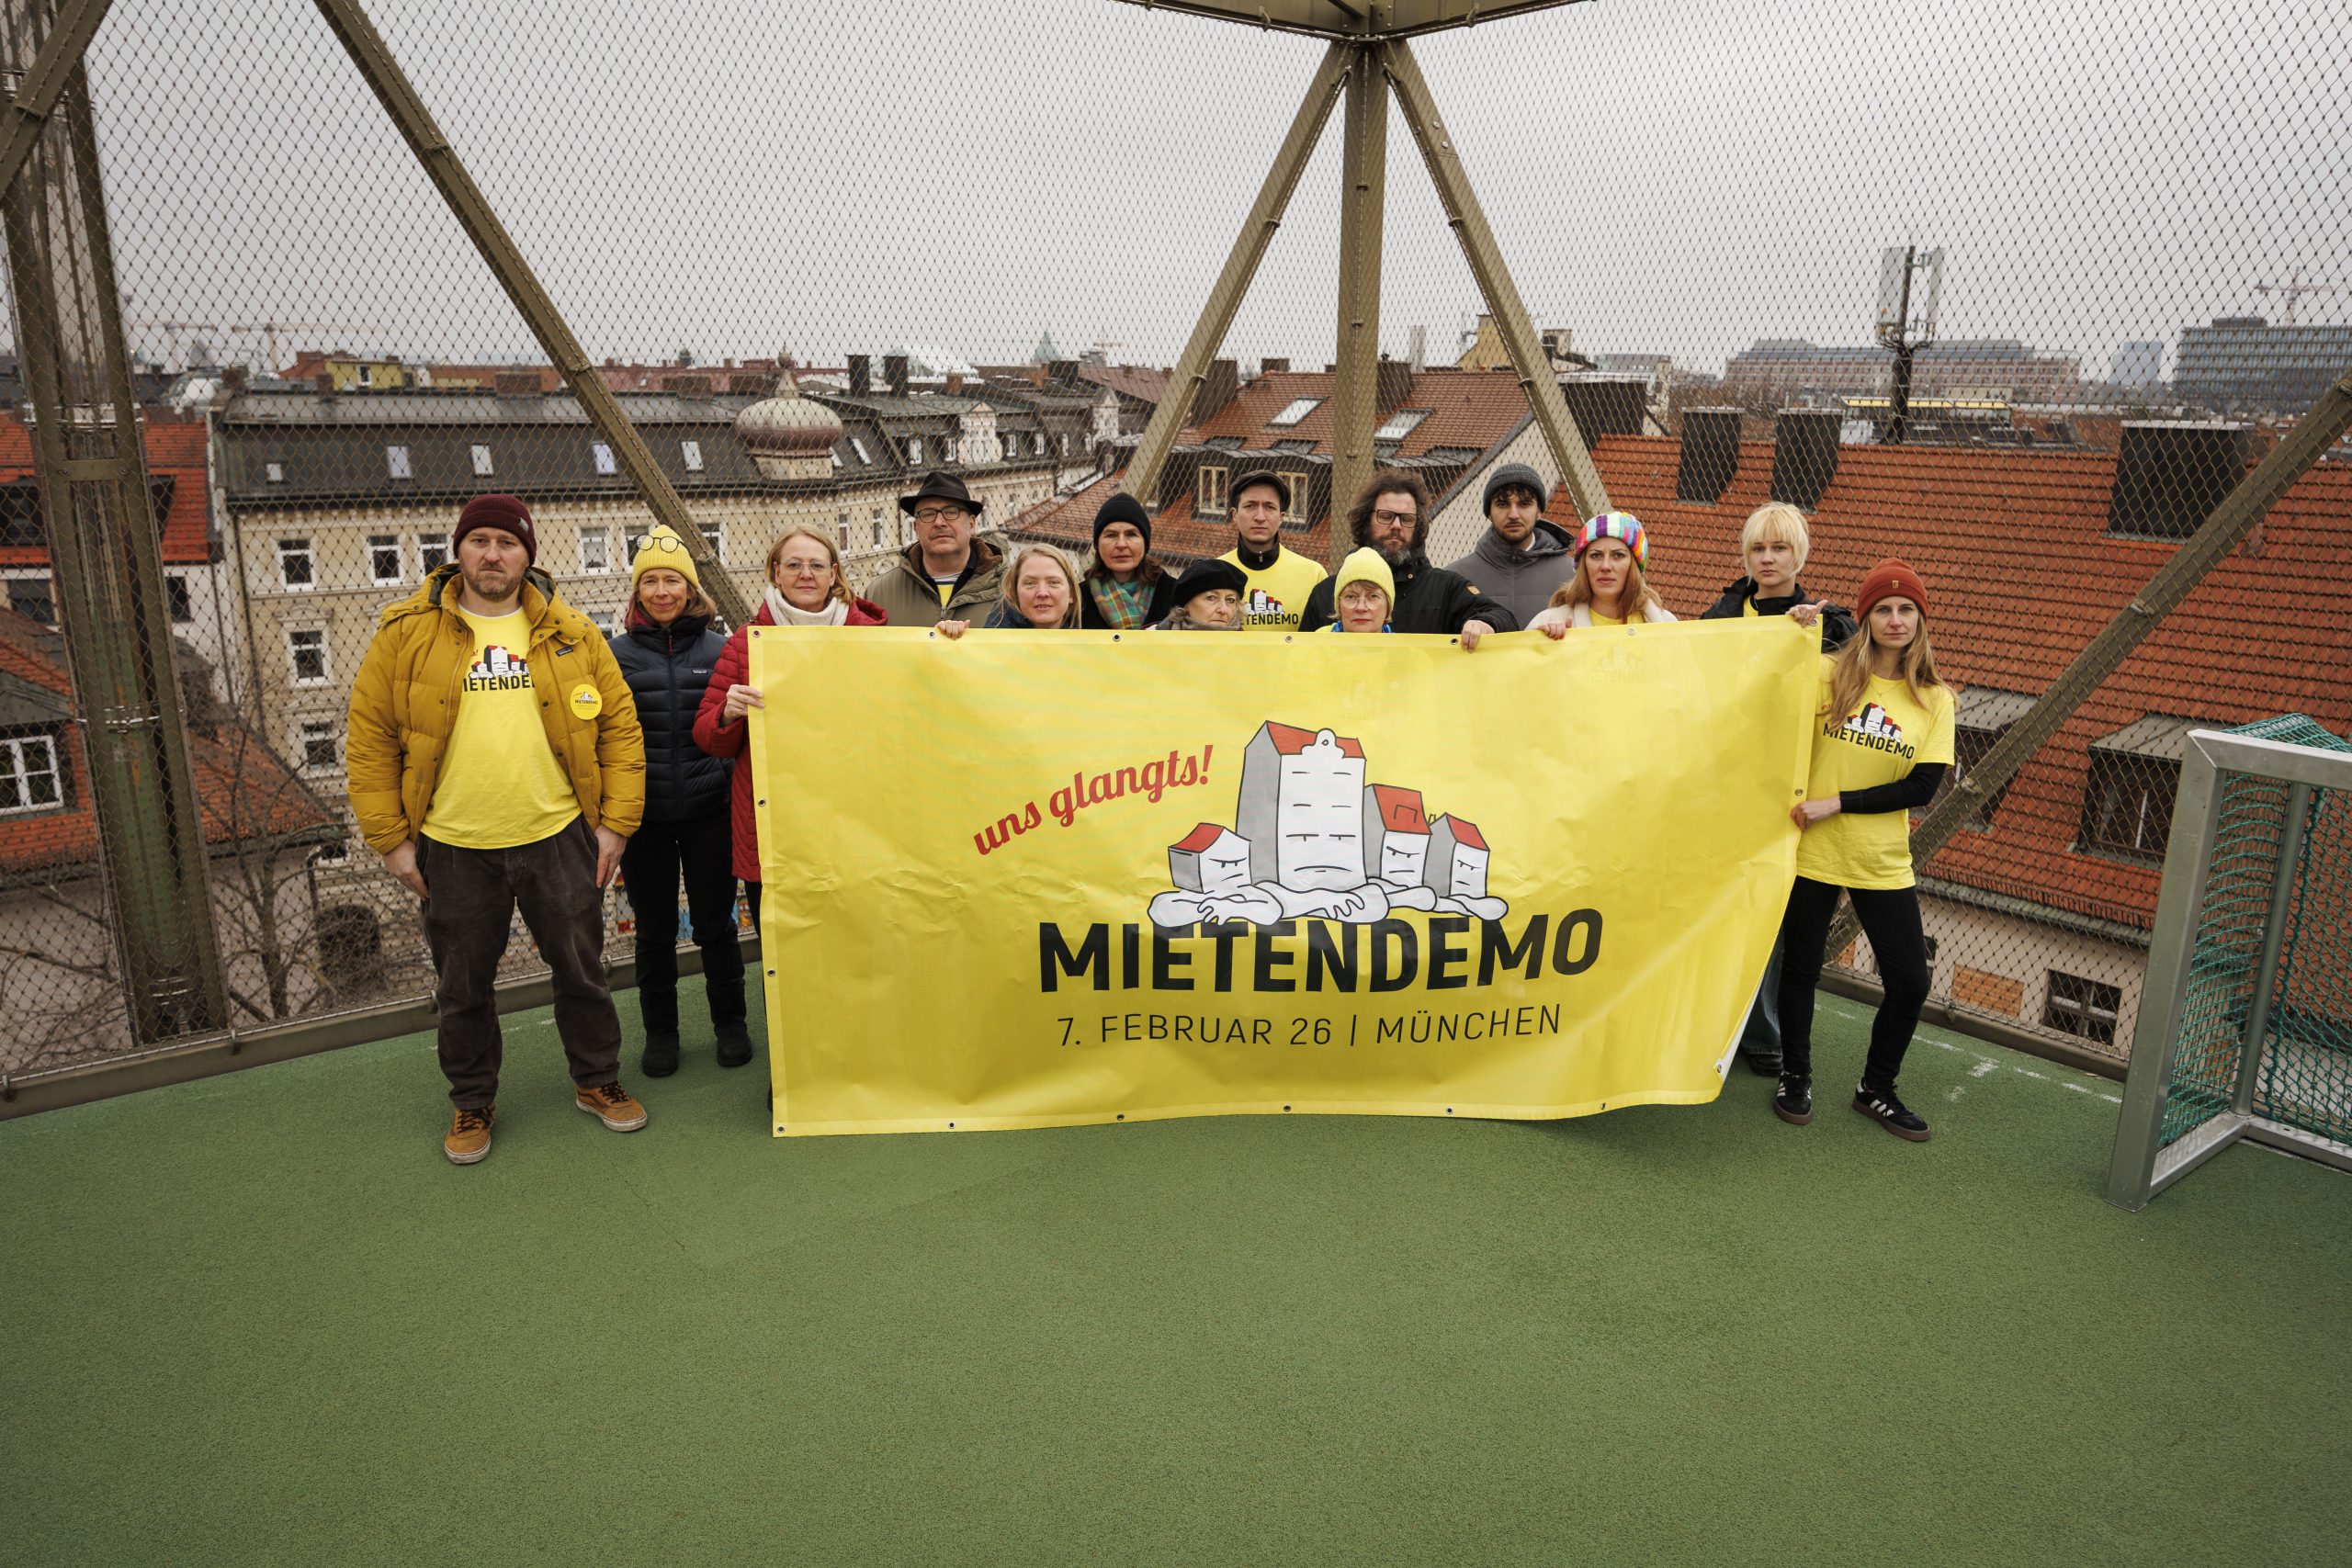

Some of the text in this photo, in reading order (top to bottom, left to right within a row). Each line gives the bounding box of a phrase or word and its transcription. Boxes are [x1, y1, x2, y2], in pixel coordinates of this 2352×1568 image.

[1240, 613, 1299, 625] TENDEMO
[462, 674, 535, 692] IETENDE
[973, 744, 1214, 855] uns glangts!
[1039, 908, 1604, 993] MIETENDEMO
[1057, 1018, 1082, 1046] 7.
[1102, 1013, 1272, 1045] FEBRUAR
[1290, 1017, 1332, 1045] 26
[1376, 1004, 1560, 1043] MÜNCHEN
